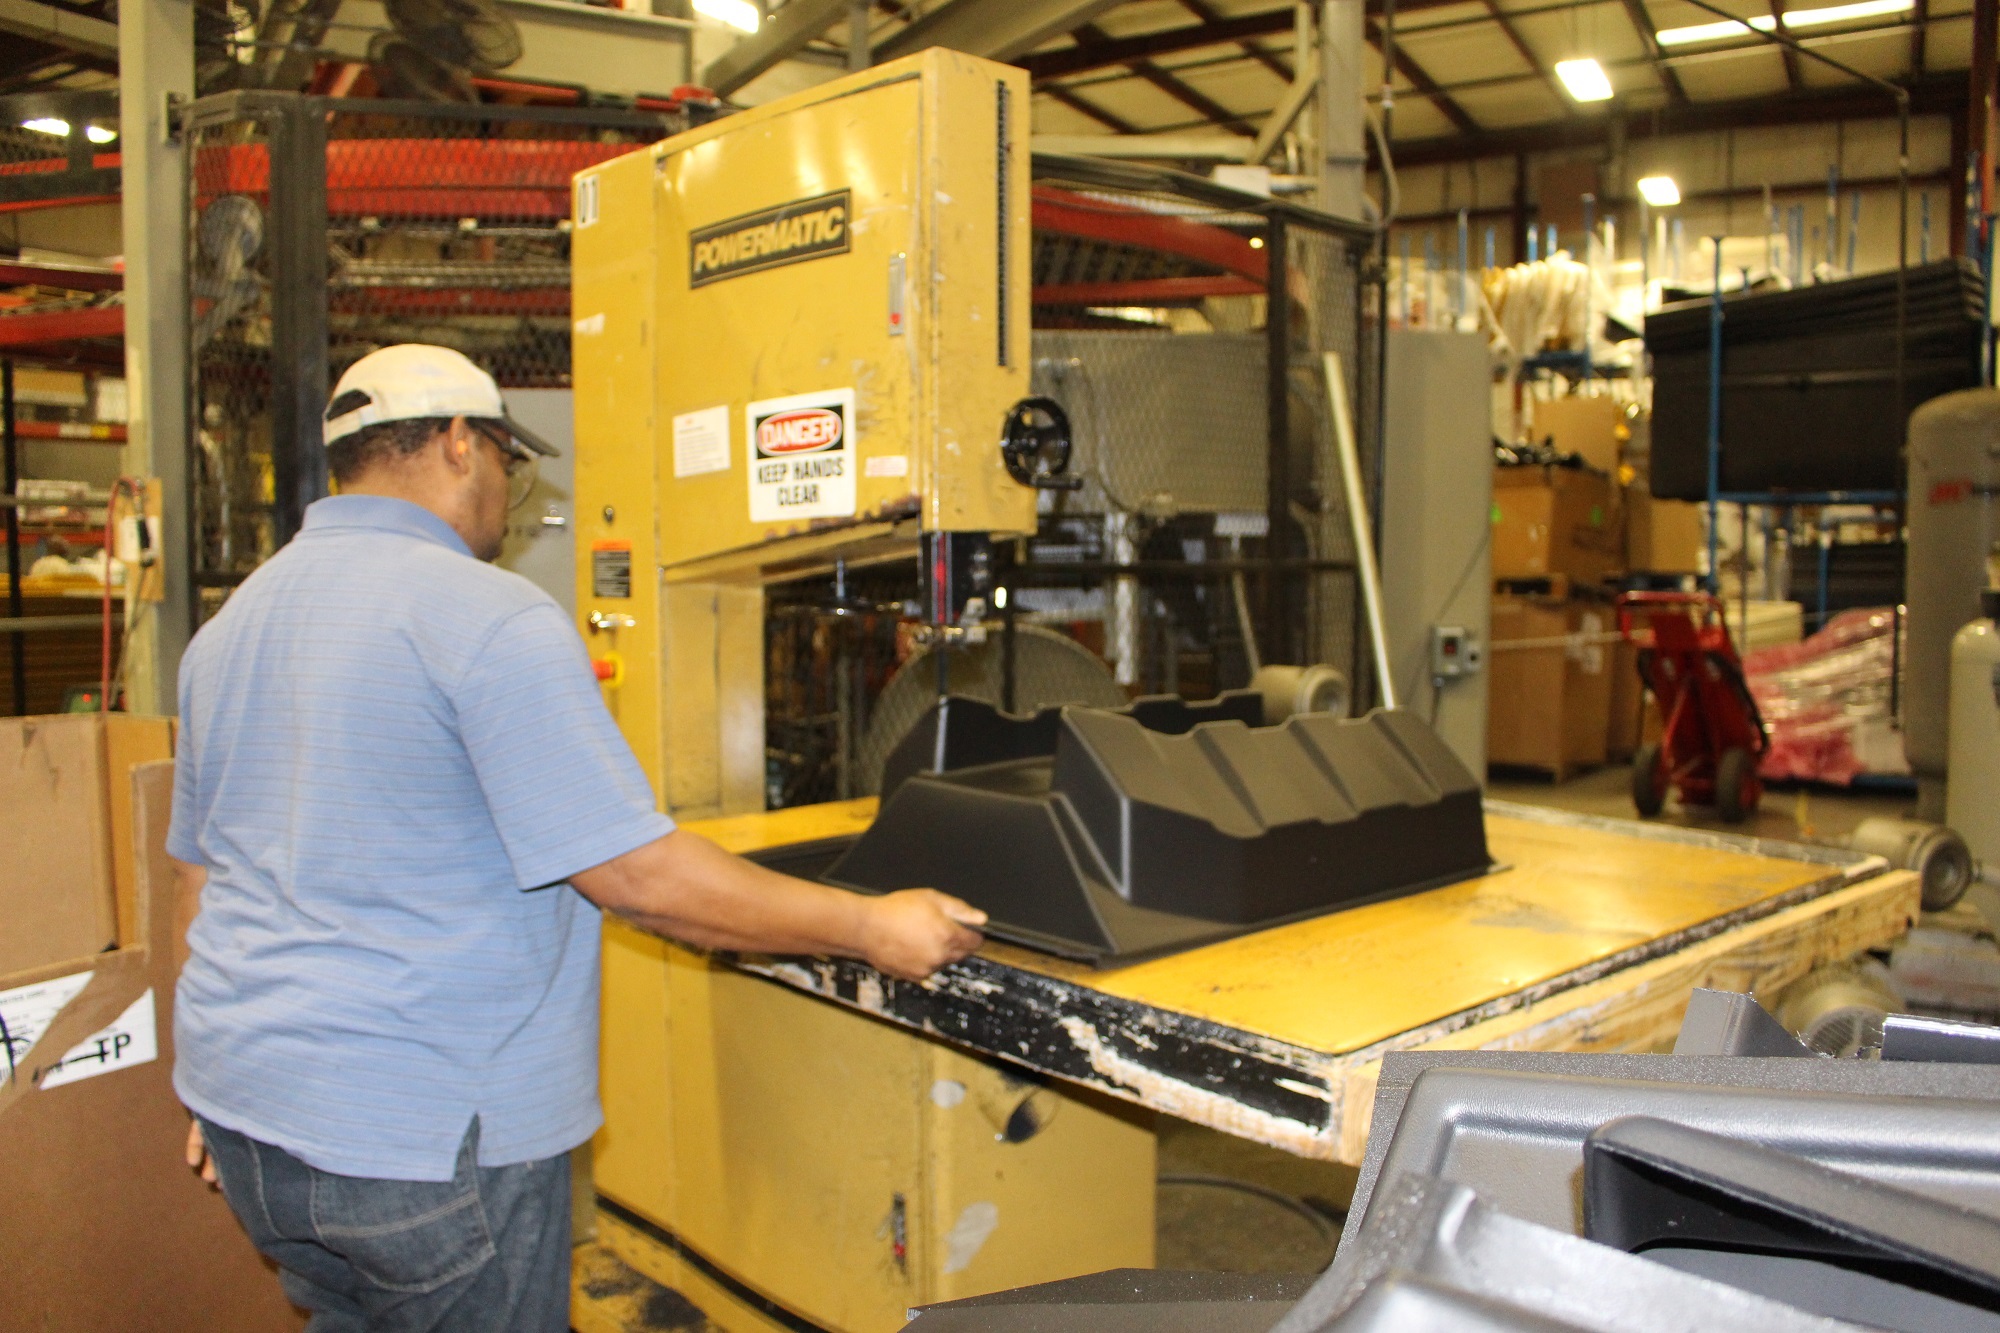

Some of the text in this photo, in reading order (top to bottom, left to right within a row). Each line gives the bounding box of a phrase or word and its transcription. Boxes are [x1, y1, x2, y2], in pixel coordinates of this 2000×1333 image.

[693, 205, 845, 274] POWERMATIC
[759, 414, 838, 450] DANGER
[756, 462, 788, 485] KEEP
[793, 457, 845, 479] HANDS
[777, 484, 820, 506] CLEAR
